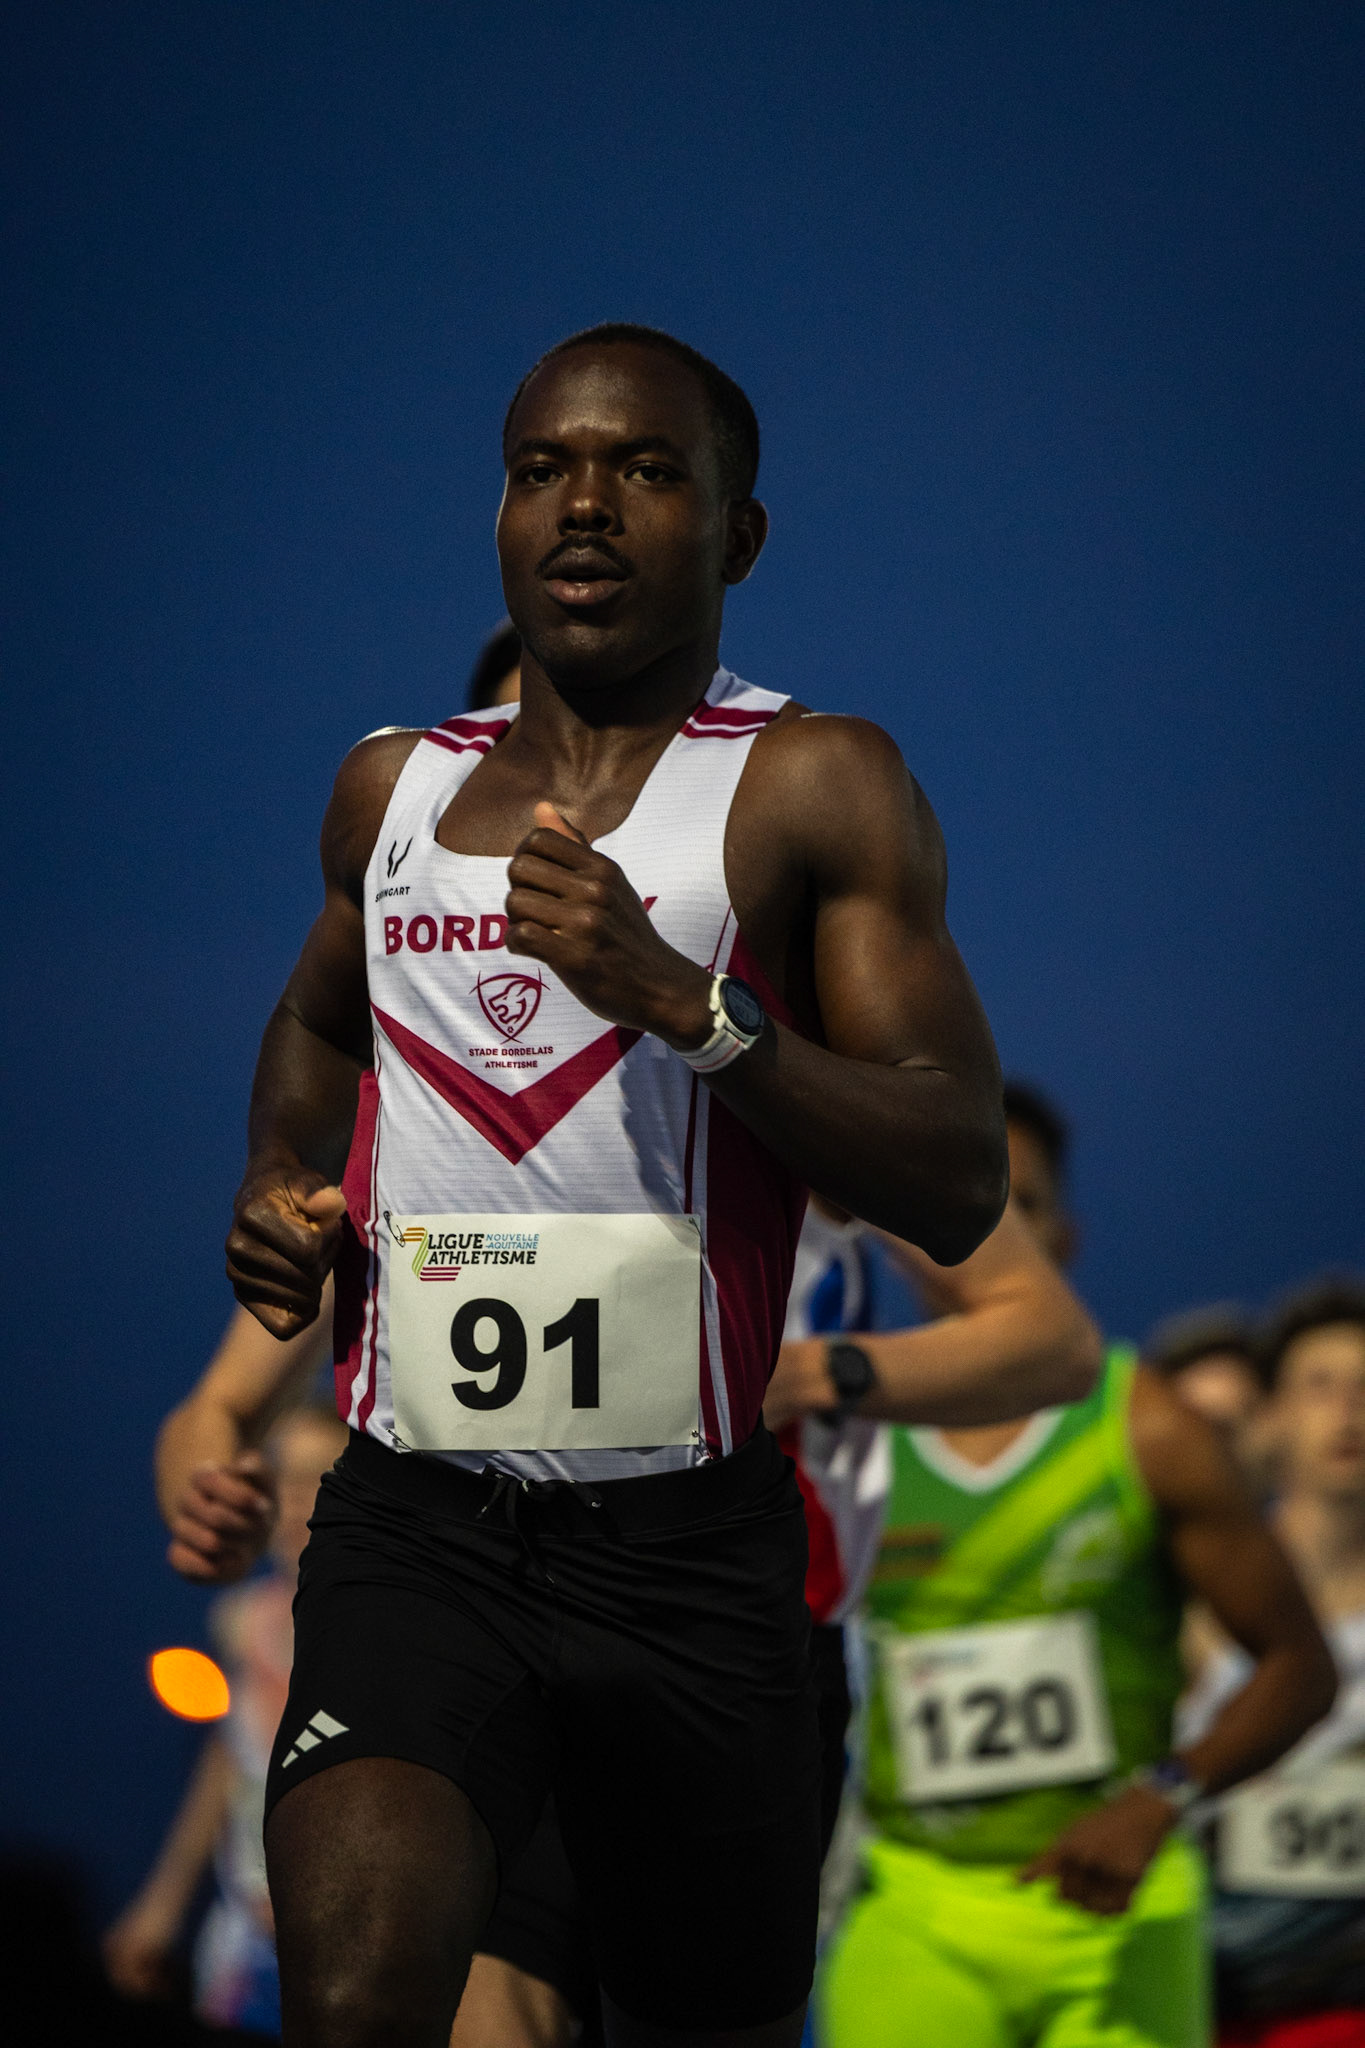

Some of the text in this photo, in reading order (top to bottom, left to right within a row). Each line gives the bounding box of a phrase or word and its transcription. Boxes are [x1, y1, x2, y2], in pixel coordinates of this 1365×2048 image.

[468, 1046, 553, 1056] STADE BORDELAIS
[484, 1061, 538, 1069] ATHLETISME
[428, 1233, 484, 1249] LIGUE
[486, 1233, 539, 1241] NOUVELLE
[485, 1241, 538, 1249] -AQUITAINE
[428, 1251, 536, 1265] ATHLETISME
[450, 1298, 600, 1411] 91
[913, 1677, 1077, 1769] 120
